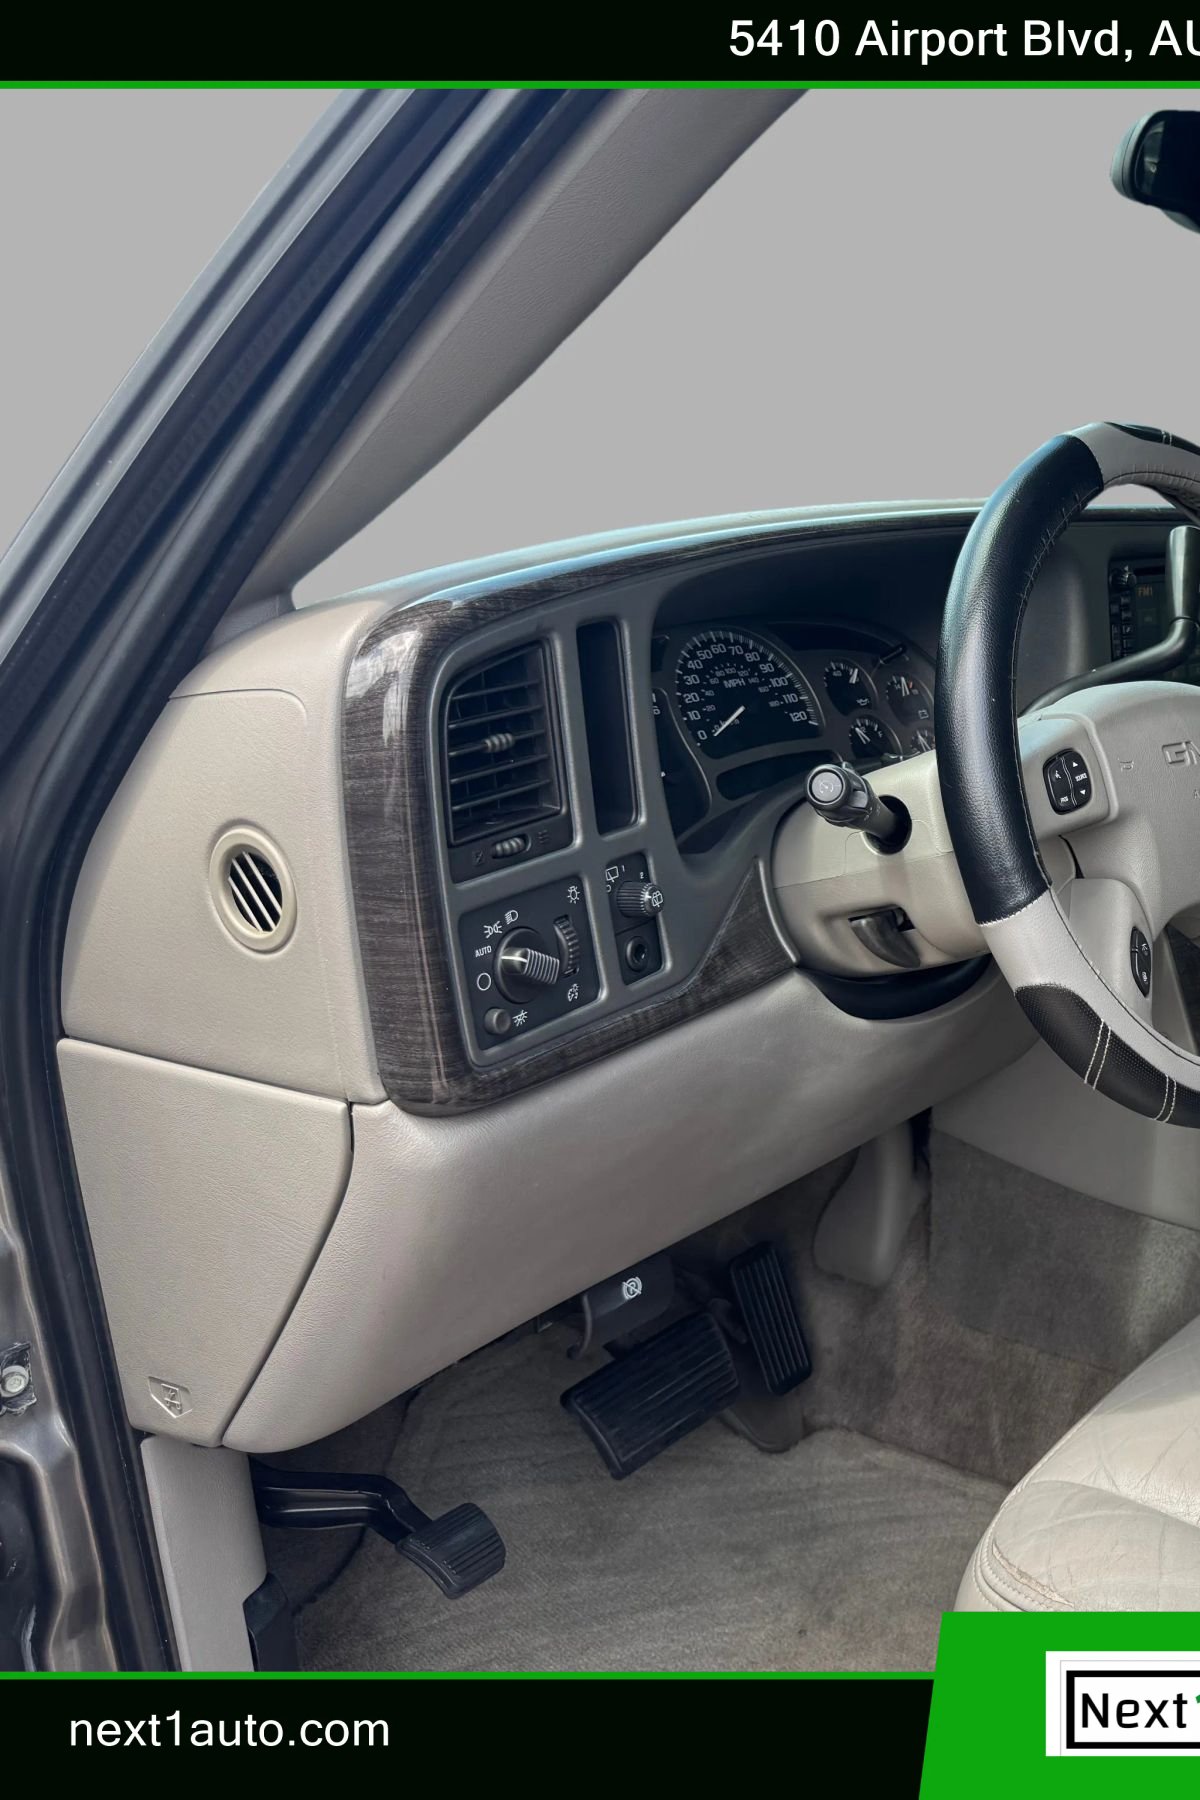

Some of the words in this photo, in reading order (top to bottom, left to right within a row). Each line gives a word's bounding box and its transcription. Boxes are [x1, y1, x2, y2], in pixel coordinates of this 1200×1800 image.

[696, 649, 713, 661] 50
[710, 643, 727, 655] 60
[728, 645, 744, 656] 70
[745, 651, 761, 662] 80
[687, 659, 704, 671] 40
[760, 662, 775, 674] 90
[683, 674, 700, 686] 30
[723, 678, 746, 689] MPH
[769, 676, 789, 688] 100
[682, 692, 700, 704] 20
[782, 693, 799, 704] 110
[687, 710, 702, 722] 10
[789, 711, 808, 723] 120
[697, 730, 708, 740] 0
[474, 945, 492, 958] AUTO
